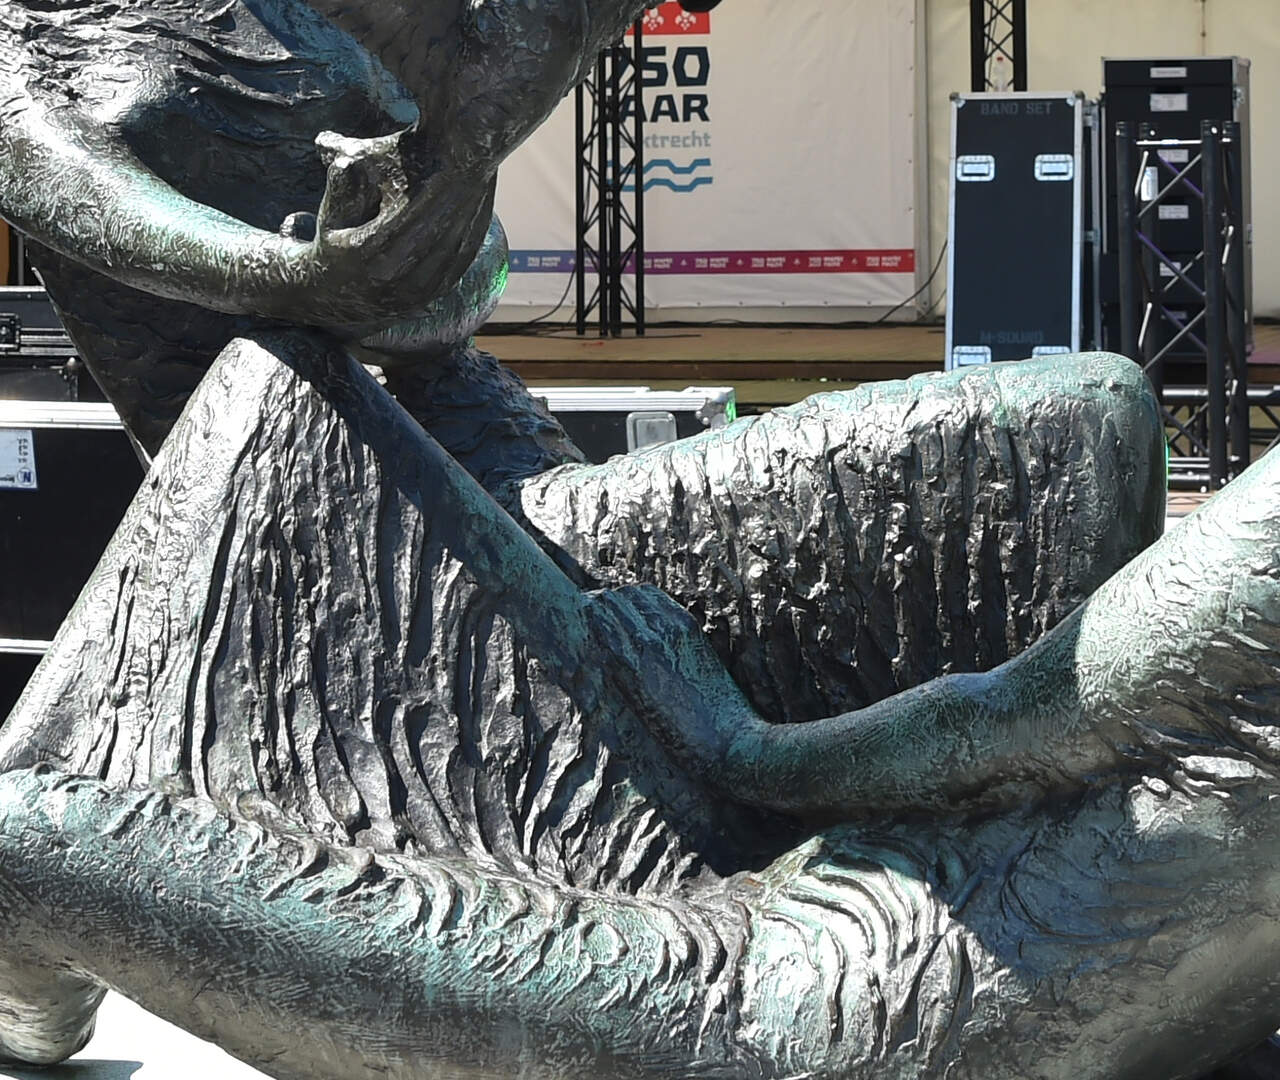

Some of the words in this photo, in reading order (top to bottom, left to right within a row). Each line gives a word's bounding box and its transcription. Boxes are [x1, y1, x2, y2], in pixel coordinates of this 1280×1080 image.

[615, 94, 710, 123] AAR
[980, 101, 1018, 116] BAND
[1025, 101, 1053, 115] SET
